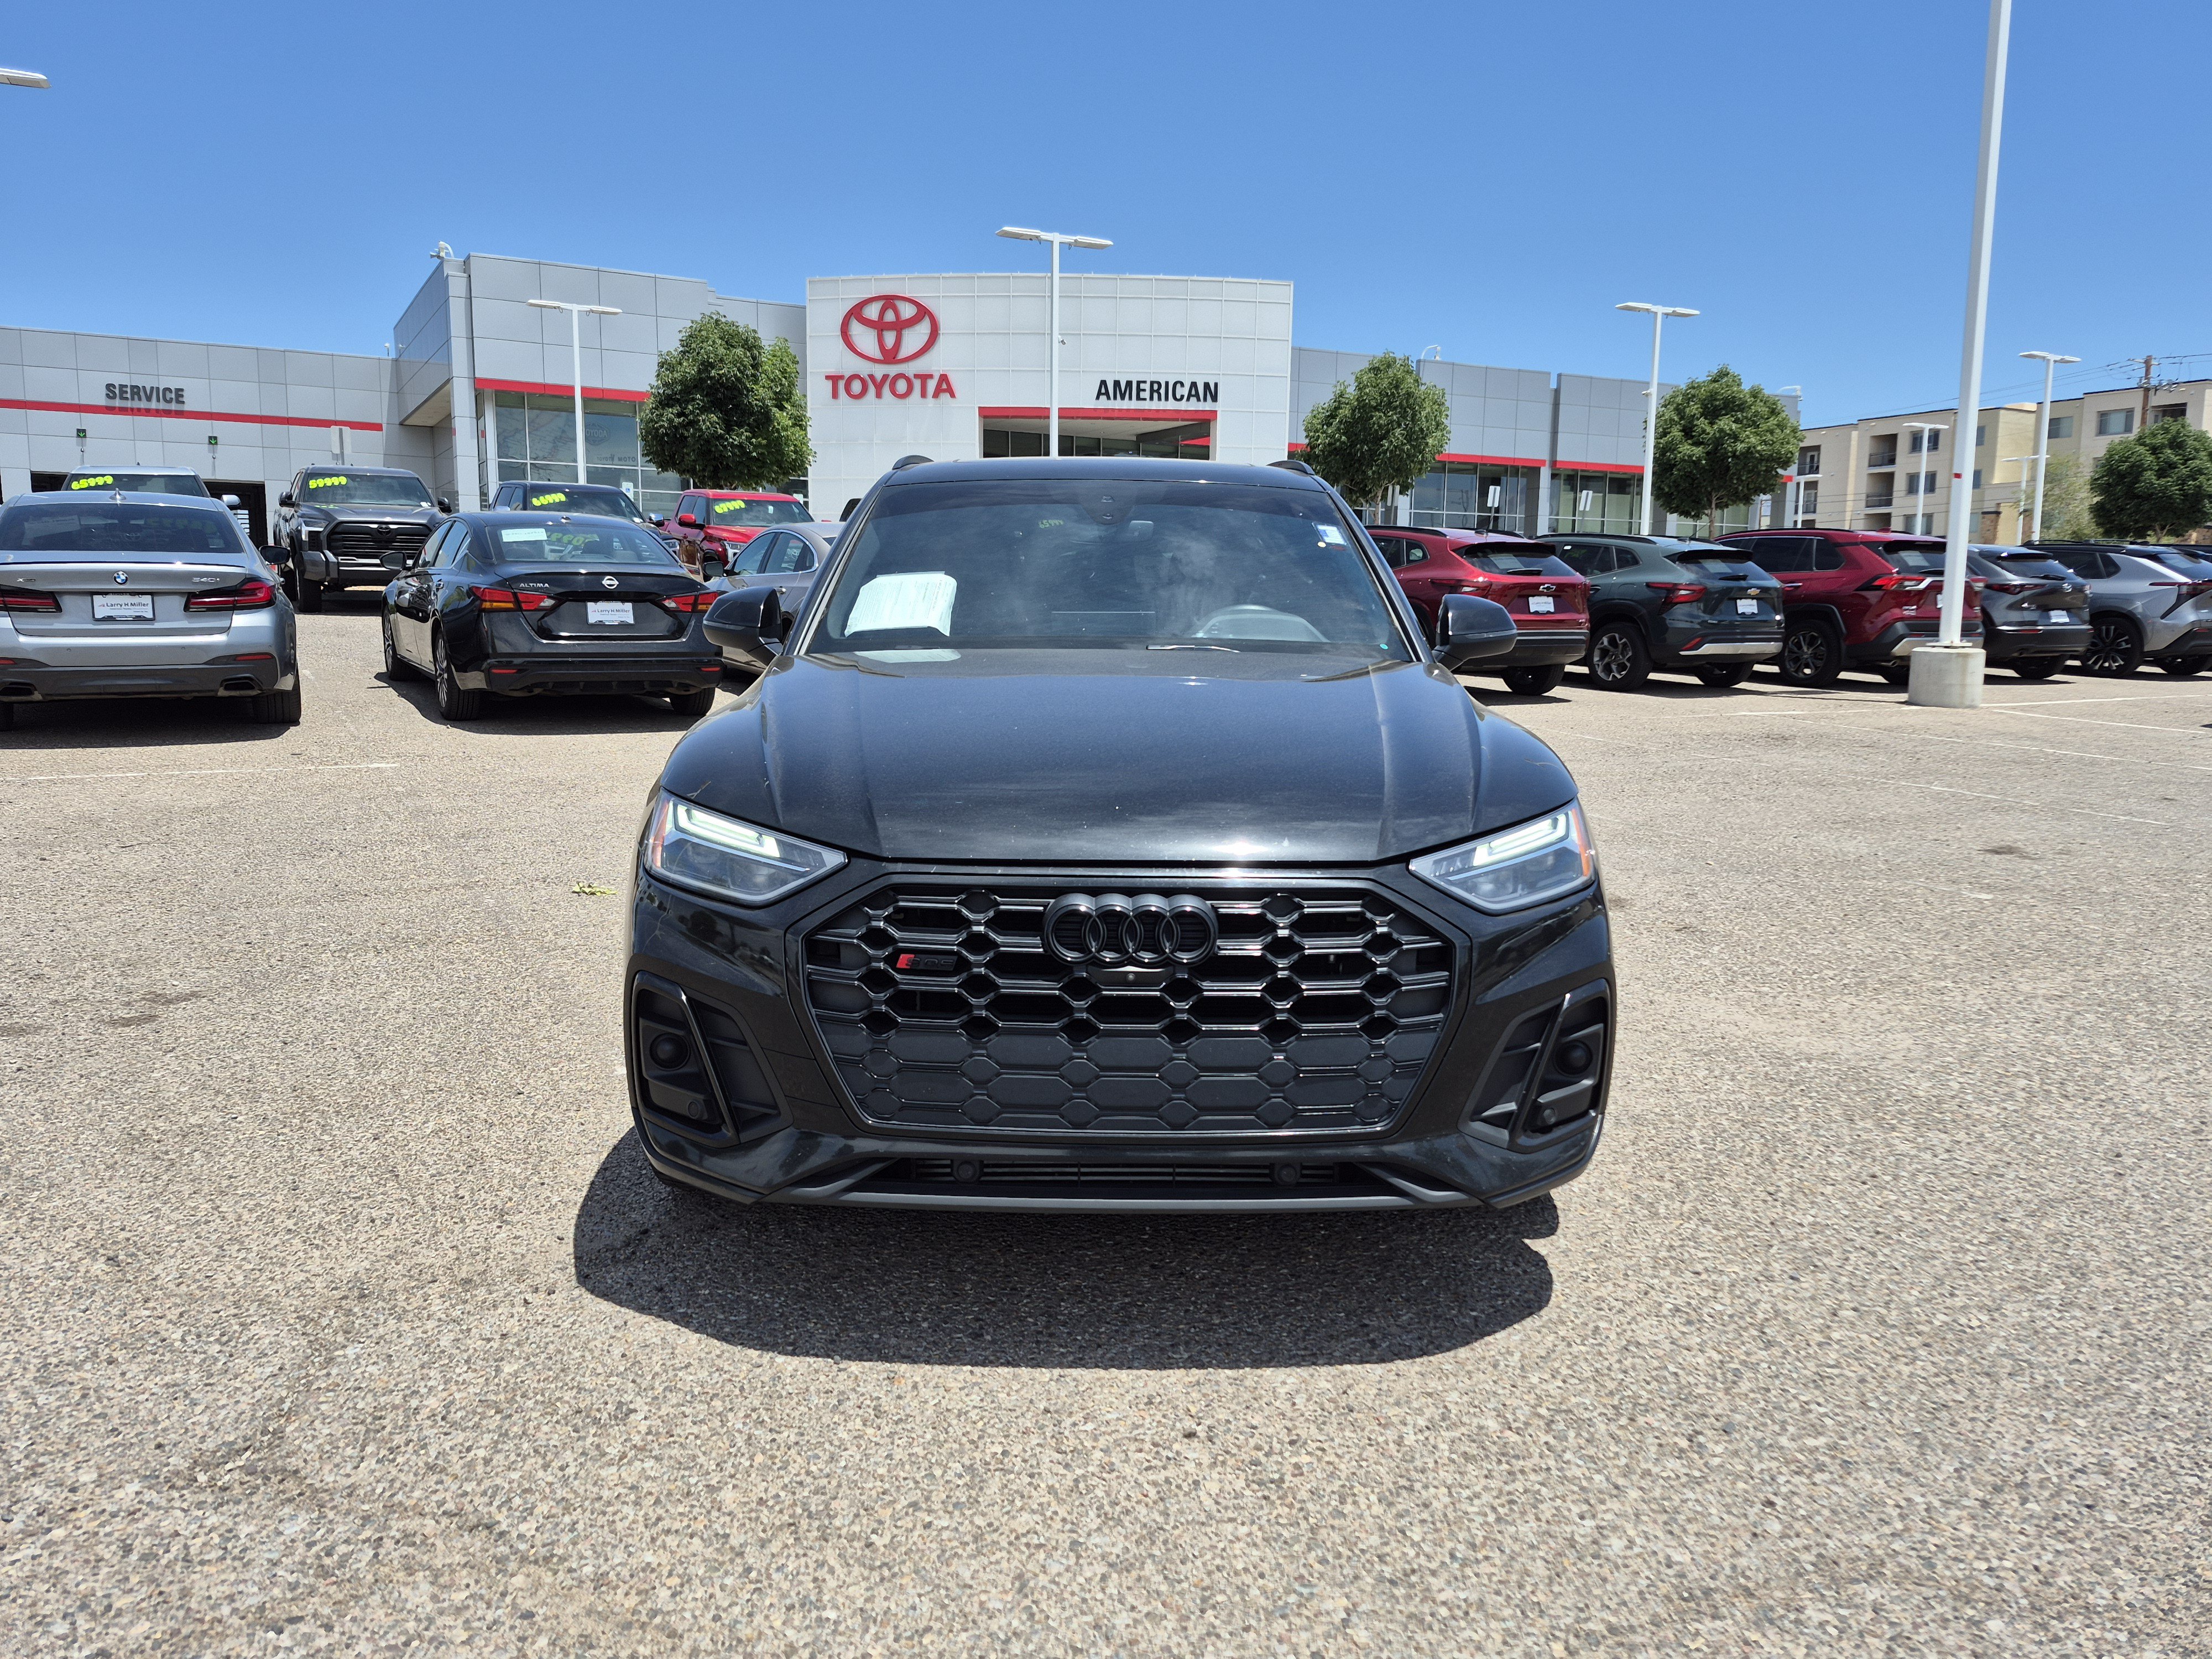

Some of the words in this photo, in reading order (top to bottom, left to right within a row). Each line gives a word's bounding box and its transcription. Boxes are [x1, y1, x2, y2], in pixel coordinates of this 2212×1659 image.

[105, 383, 185, 404] SERVICE
[825, 373, 957, 400] TOYOTA
[1095, 379, 1218, 403] AMERICAN
[71, 475, 113, 490] 65999
[309, 476, 347, 489] 59999
[532, 492, 566, 506] 66999
[714, 500, 745, 514] 67999
